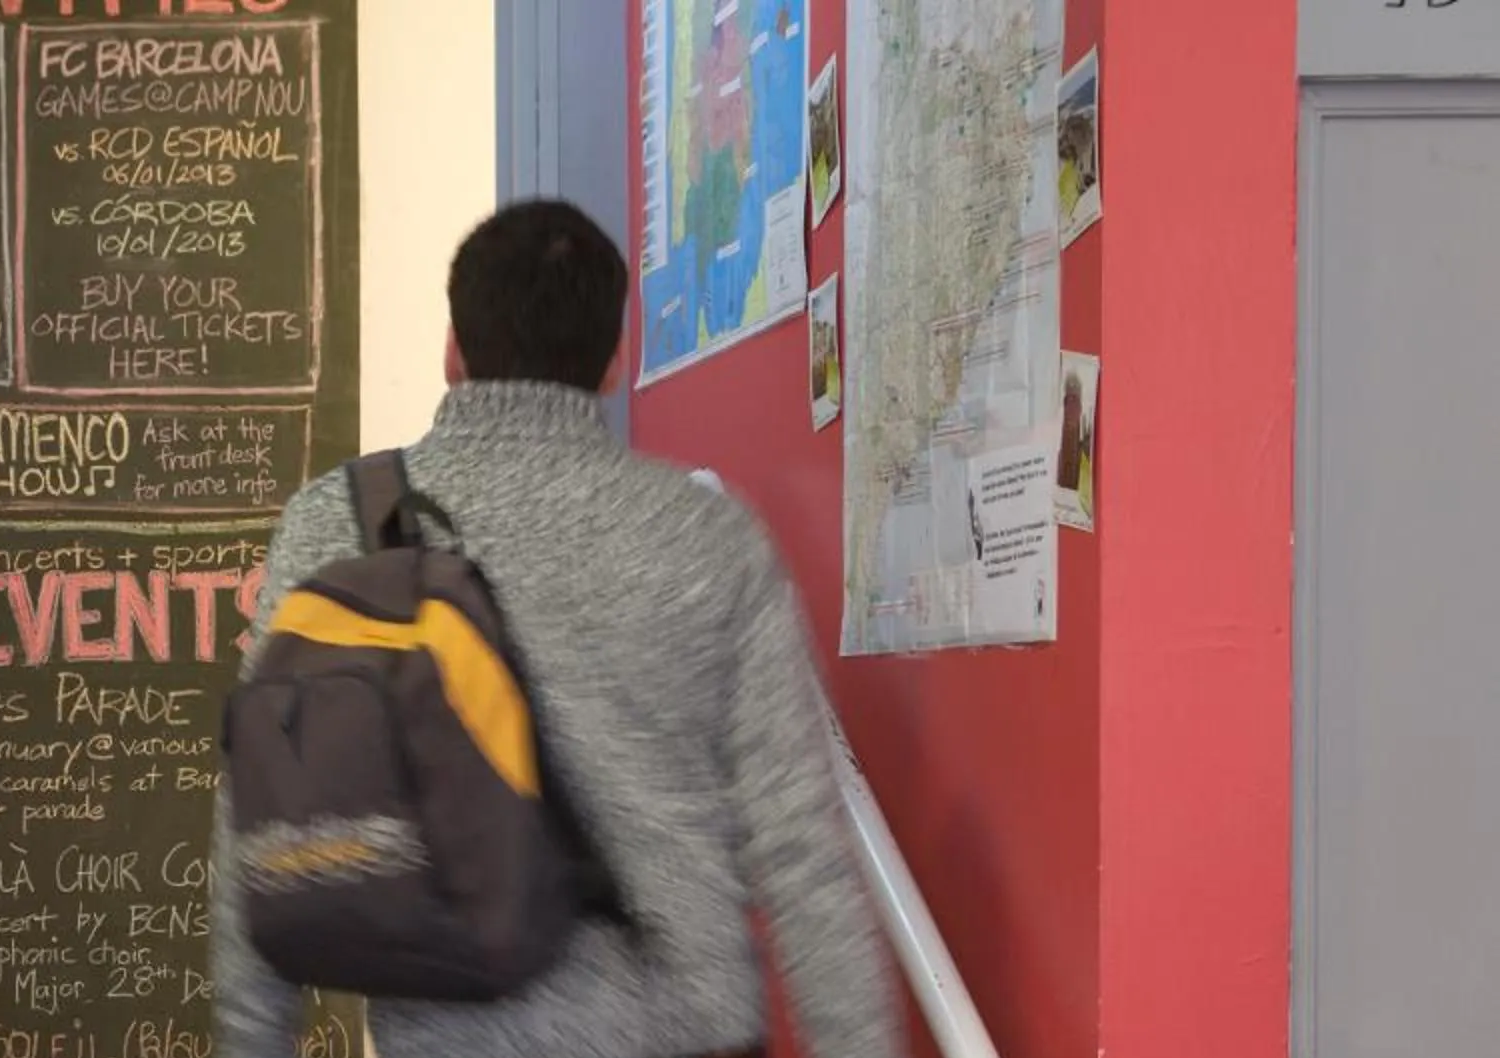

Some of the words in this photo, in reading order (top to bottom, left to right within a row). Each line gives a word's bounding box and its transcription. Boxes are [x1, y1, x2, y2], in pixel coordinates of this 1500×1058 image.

[40, 41, 88, 79] FC
[97, 35, 283, 79] BARCELONA
[255, 76, 305, 117] NOU
[90, 127, 153, 161] RCD
[163, 120, 299, 163] ESPAÑOL
[102, 158, 236, 188] 06/01/2013
[90, 194, 256, 226] CÓRDOBA
[80, 273, 144, 311] BUY
[158, 276, 242, 311] YOUR
[31, 312, 164, 344] OFFICIAL
[171, 311, 301, 345] TICKETS
[109, 344, 209, 379] HERE!
[143, 416, 189, 446] Ask
[200, 421, 228, 442] at
[237, 417, 275, 442] the
[155, 446, 215, 473] front
[219, 443, 273, 469] desk
[132, 473, 165, 501] for
[172, 475, 228, 497] more
[232, 471, 277, 504] info
[152, 540, 268, 583] sports
[56, 671, 204, 726] PARADE
[129, 764, 164, 791] at
[22, 794, 105, 835] parade
[56, 845, 142, 893] CHOIR
[77, 901, 107, 944] by
[181, 967, 215, 1004] De
